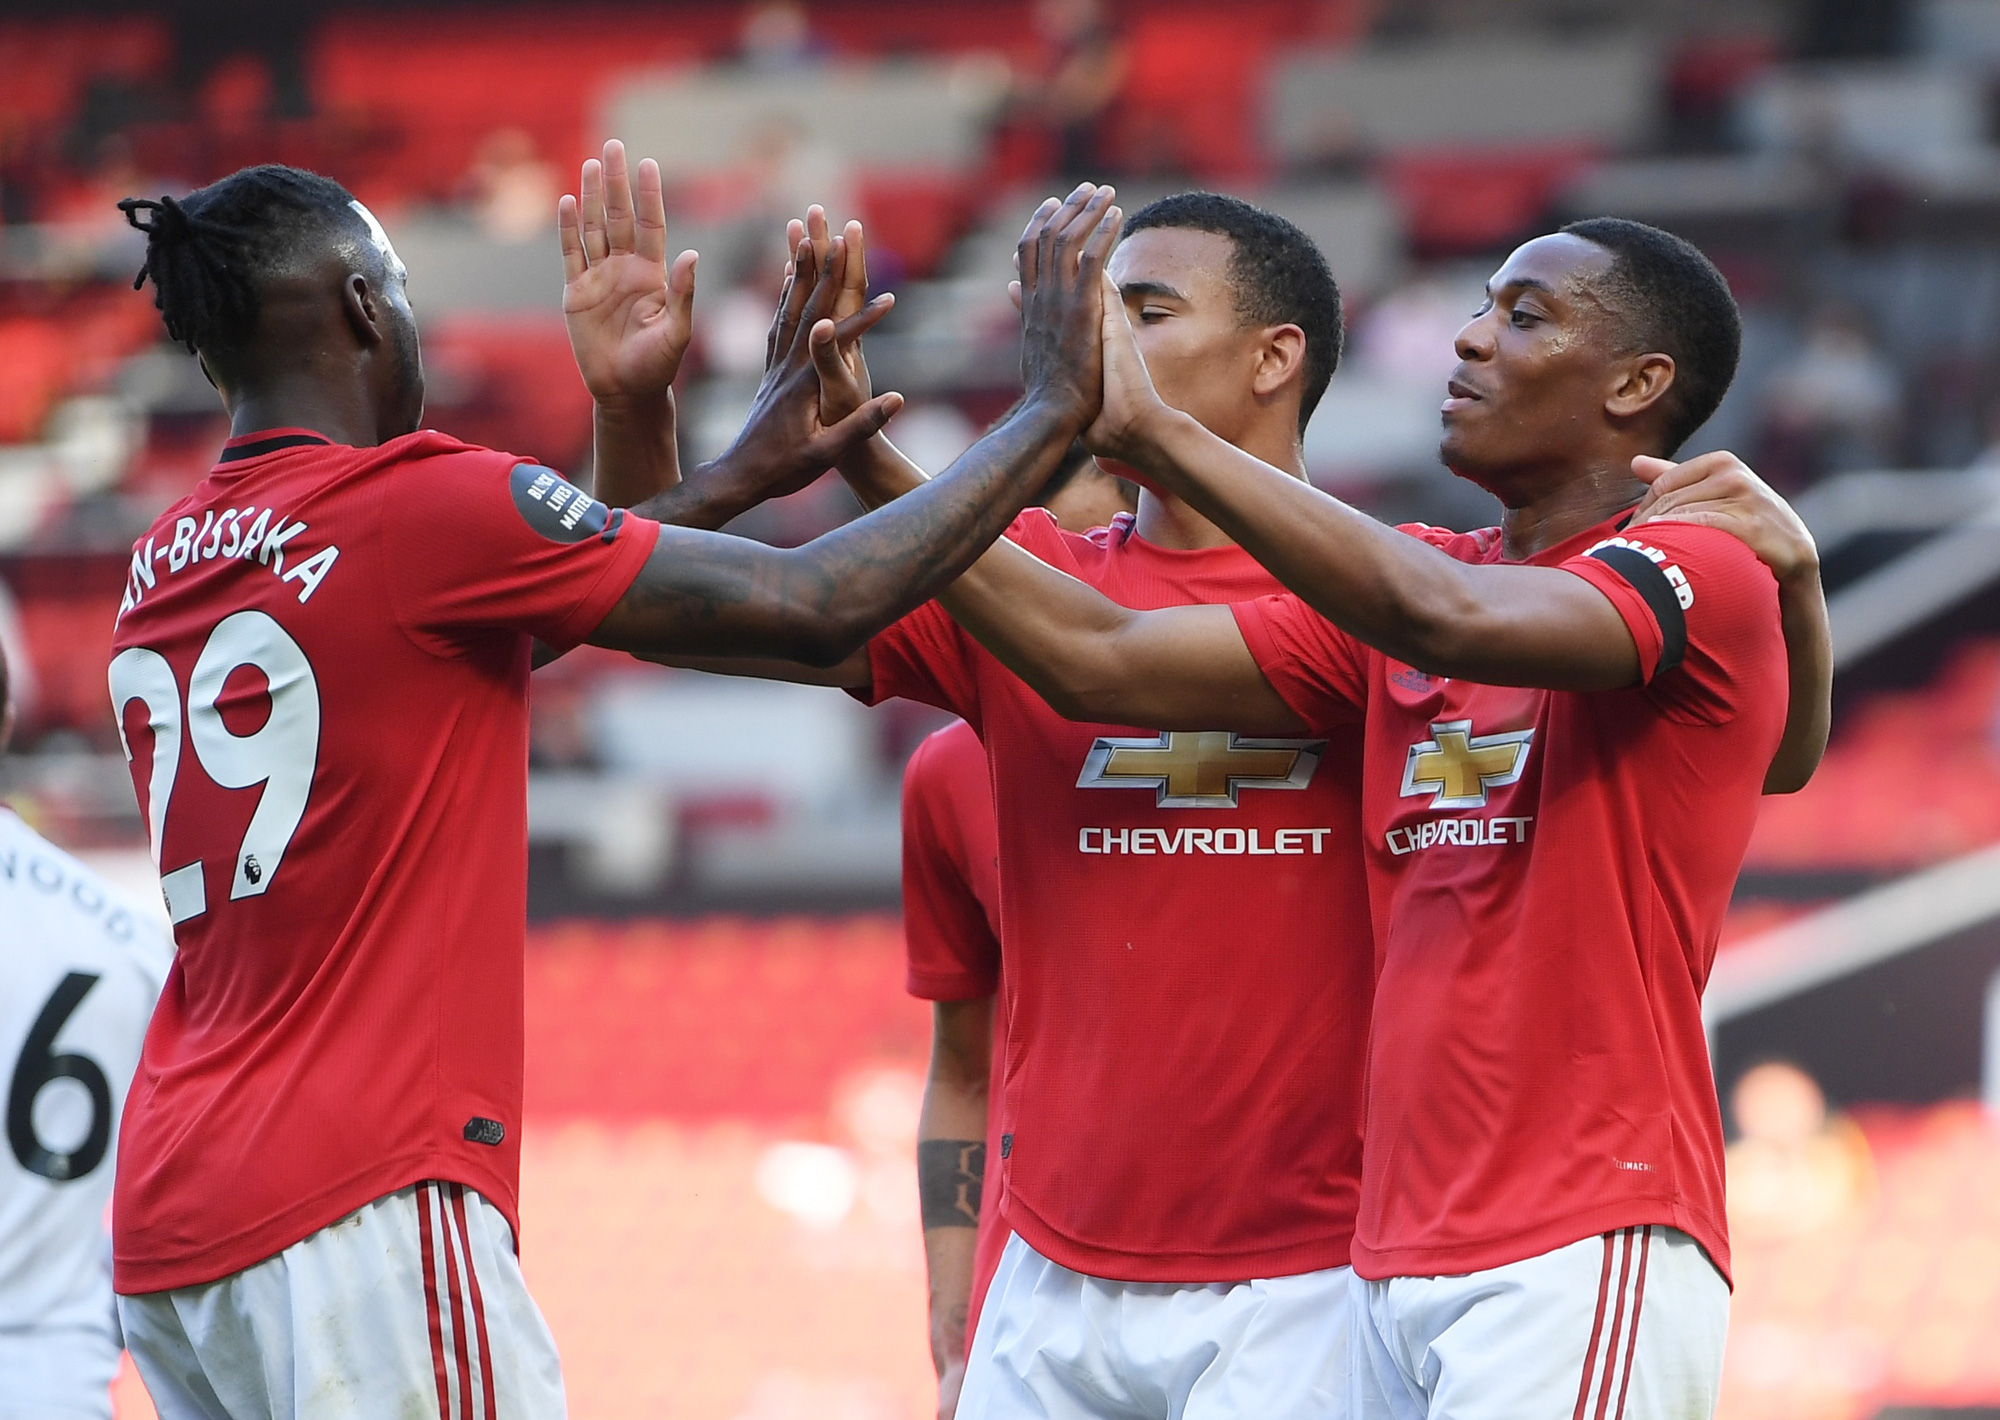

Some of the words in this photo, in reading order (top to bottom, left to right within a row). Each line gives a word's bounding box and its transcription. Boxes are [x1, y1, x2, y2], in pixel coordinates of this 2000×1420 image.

[546, 485, 574, 512] LIVES
[1581, 536, 1695, 611] HLER
[107, 609, 321, 926] 29
[1079, 827, 1332, 855] CHEVROLET
[1385, 816, 1534, 856] CHEVROLET
[6, 971, 113, 1182] 6
